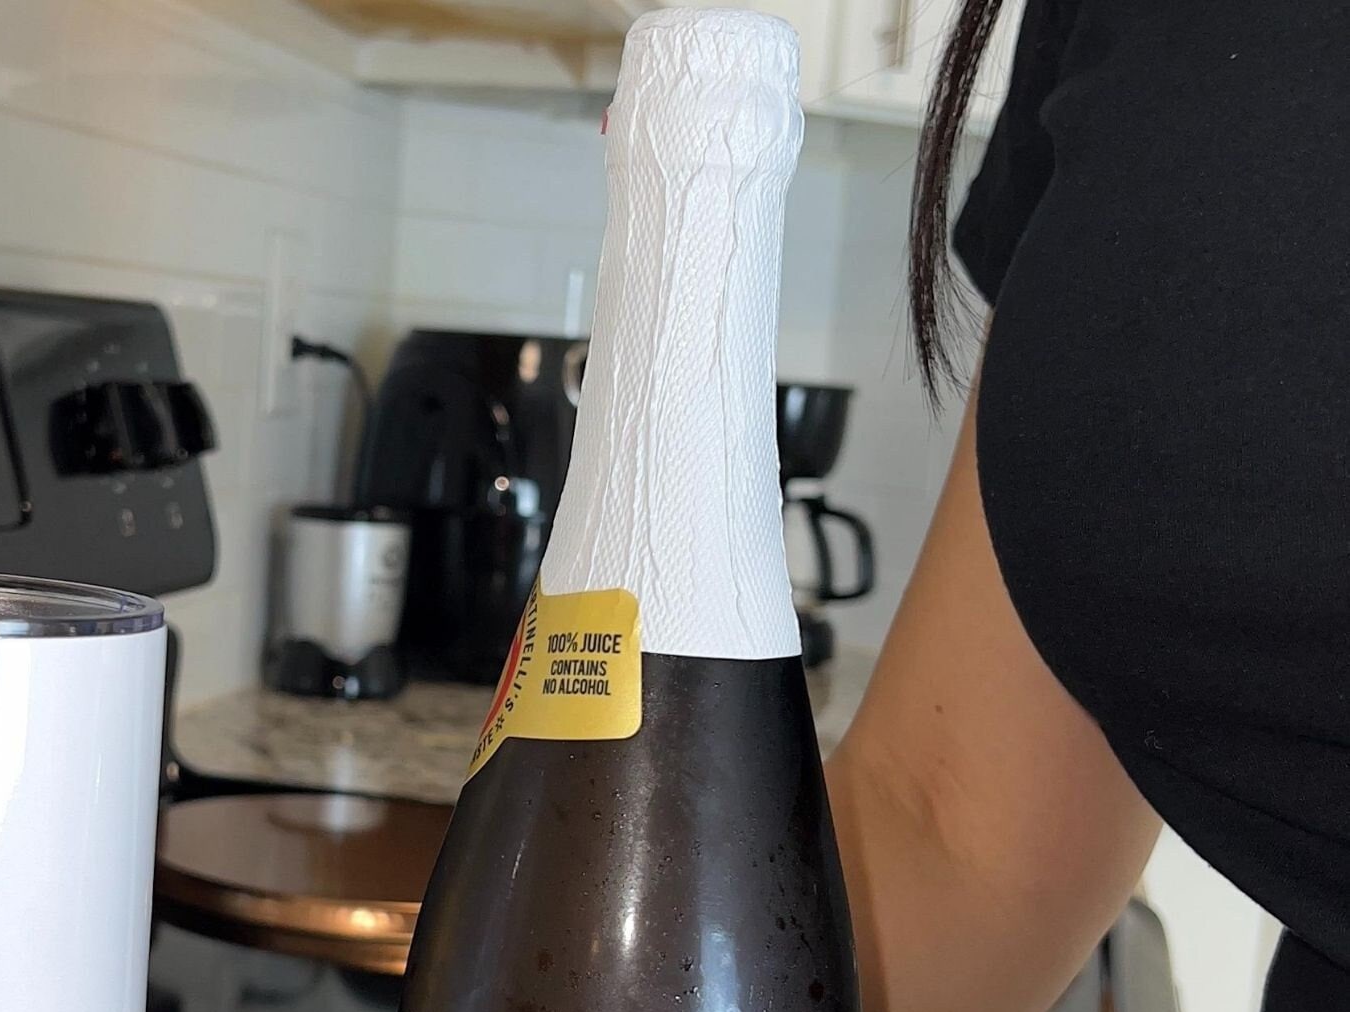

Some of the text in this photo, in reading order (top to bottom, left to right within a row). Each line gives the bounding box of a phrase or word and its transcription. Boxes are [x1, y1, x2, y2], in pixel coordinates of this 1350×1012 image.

[547, 632, 623, 654] 100% JUICE
[550, 659, 608, 676] CONTAINS
[542, 678, 611, 696] NO ALCOHOL
